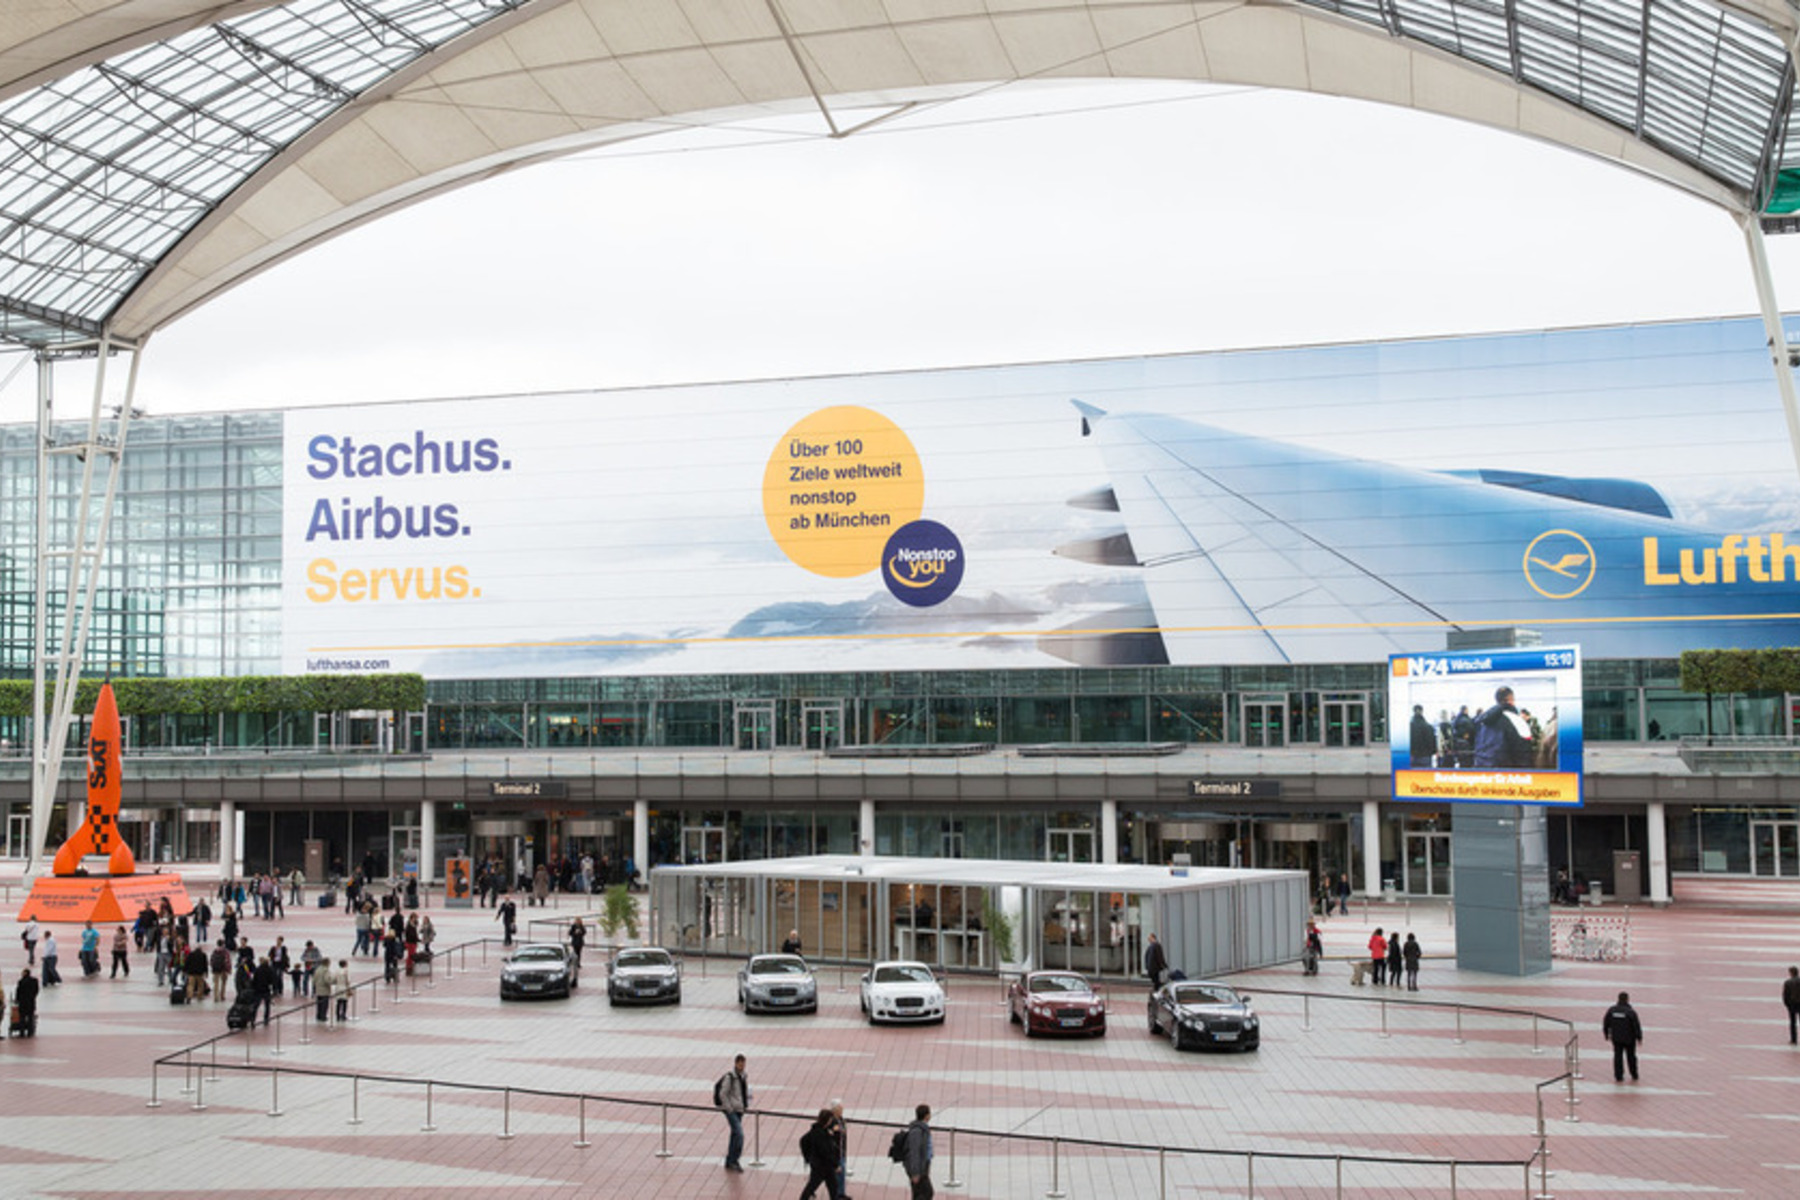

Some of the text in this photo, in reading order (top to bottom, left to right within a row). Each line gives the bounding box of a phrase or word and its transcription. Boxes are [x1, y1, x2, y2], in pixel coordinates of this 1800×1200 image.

[306, 430, 512, 480] Stachus.
[790, 438, 863, 458] Über 100
[789, 461, 902, 481] Ziele weltweit
[790, 489, 857, 506] nonstop
[305, 496, 471, 541] Airbus.
[790, 511, 891, 529] ab München
[898, 547, 957, 562] Nonstop
[1643, 533, 1800, 585] Lufth
[908, 560, 946, 579] you
[305, 557, 482, 603] Servus.
[306, 658, 390, 671] lufthansa.com
[1408, 656, 1449, 676] N24
[1544, 652, 1574, 667] 15:10
[493, 782, 541, 795] Terminal 2
[1193, 781, 1252, 795] Terminal 2
